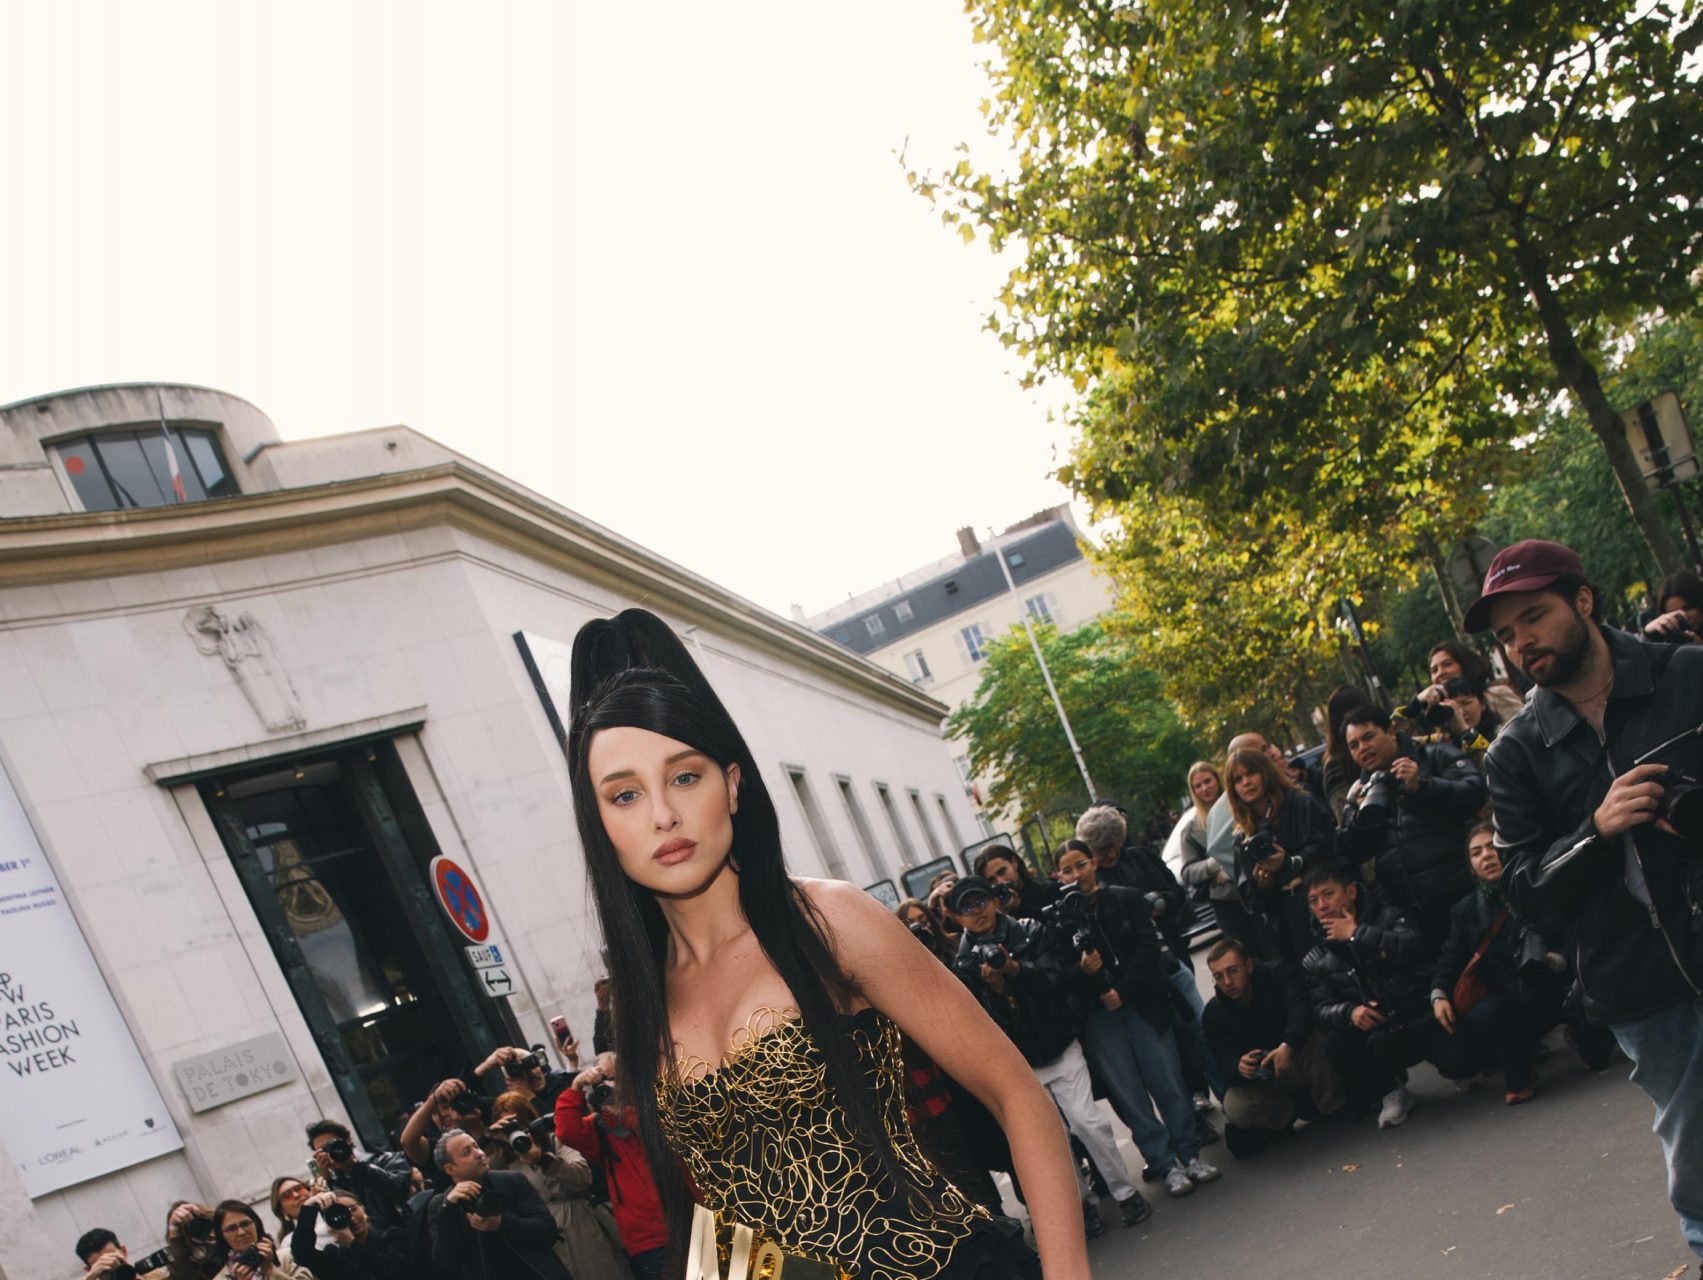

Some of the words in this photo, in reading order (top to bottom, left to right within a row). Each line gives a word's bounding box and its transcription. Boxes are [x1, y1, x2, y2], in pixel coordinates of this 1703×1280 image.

[0, 1002, 55, 1031] ARIS
[7, 1045, 76, 1078] WEEK
[183, 1049, 255, 1085] PALAIS
[193, 1082, 220, 1102] DE
